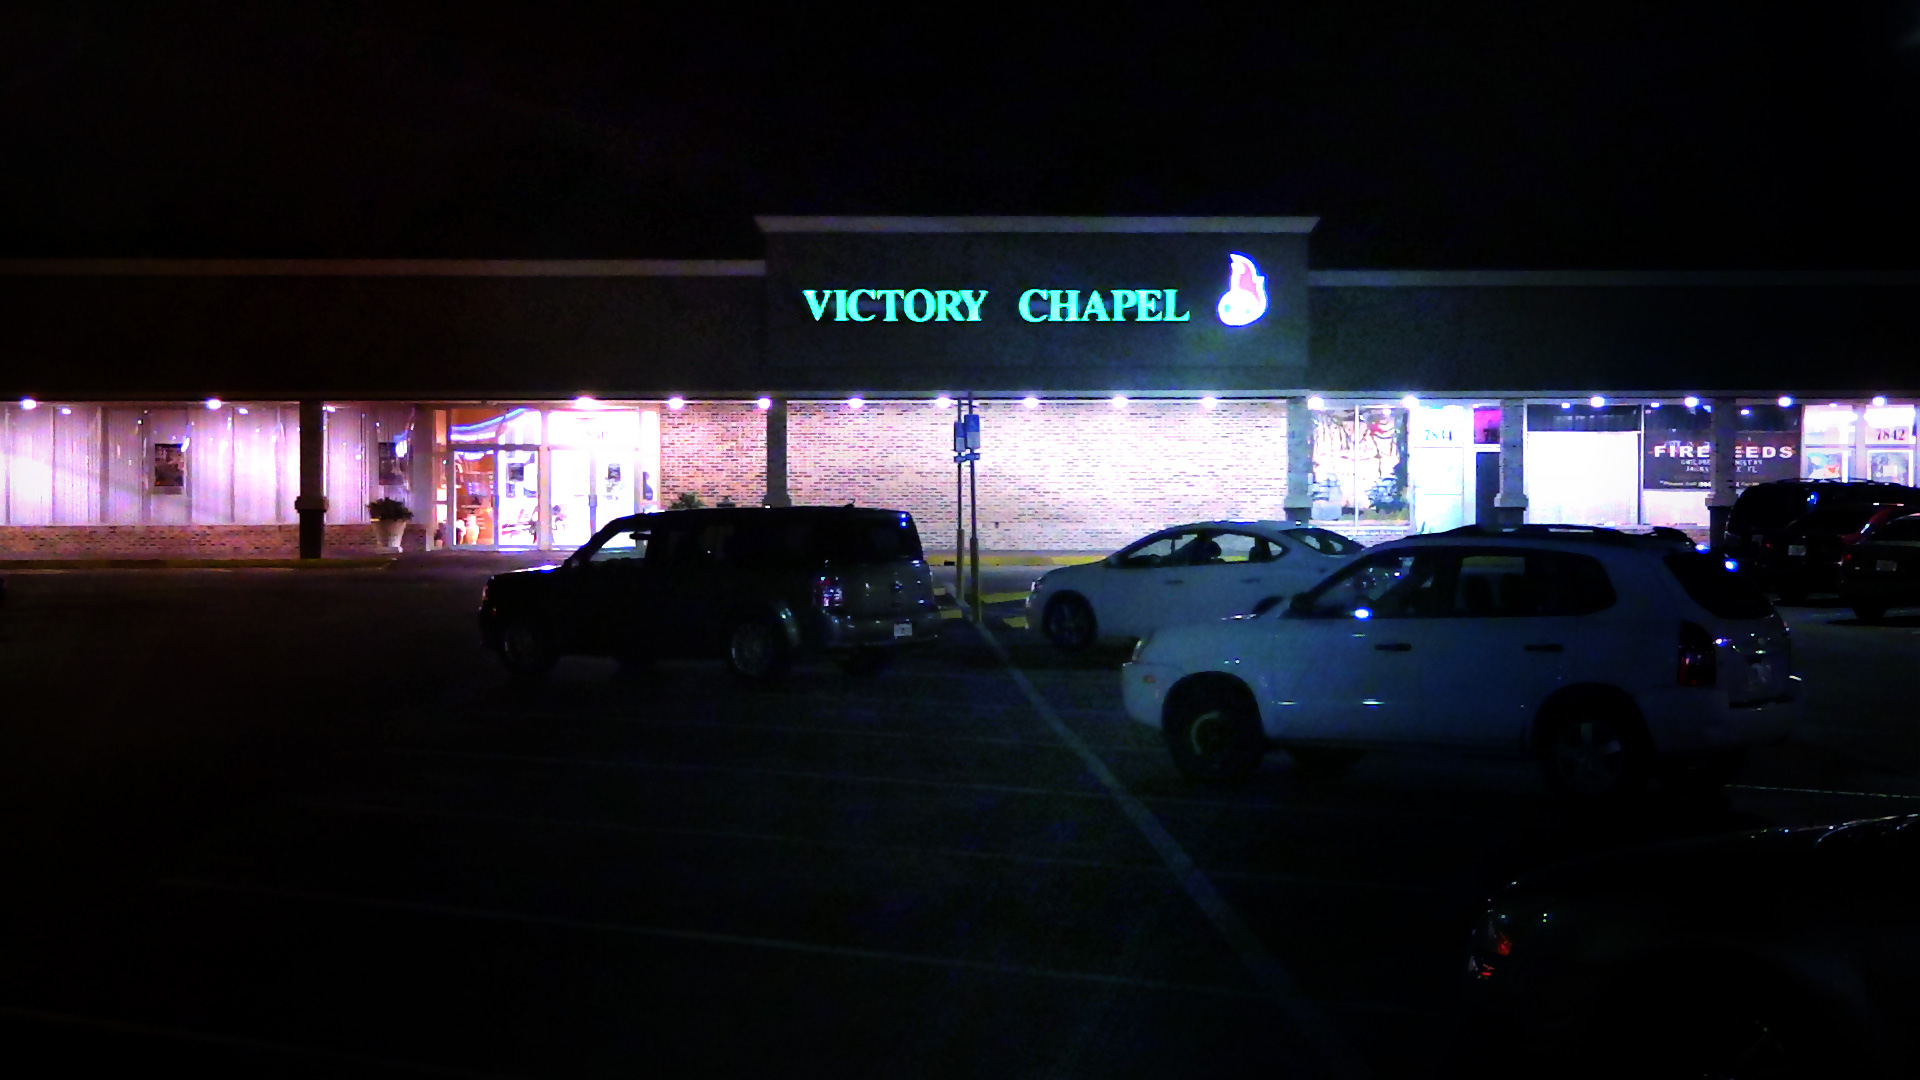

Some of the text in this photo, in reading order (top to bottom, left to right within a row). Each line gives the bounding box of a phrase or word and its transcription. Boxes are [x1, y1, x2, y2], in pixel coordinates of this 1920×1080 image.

[802, 288, 1191, 323] VICTORY CHAPEL
[1654, 445, 1711, 458] FIRE
